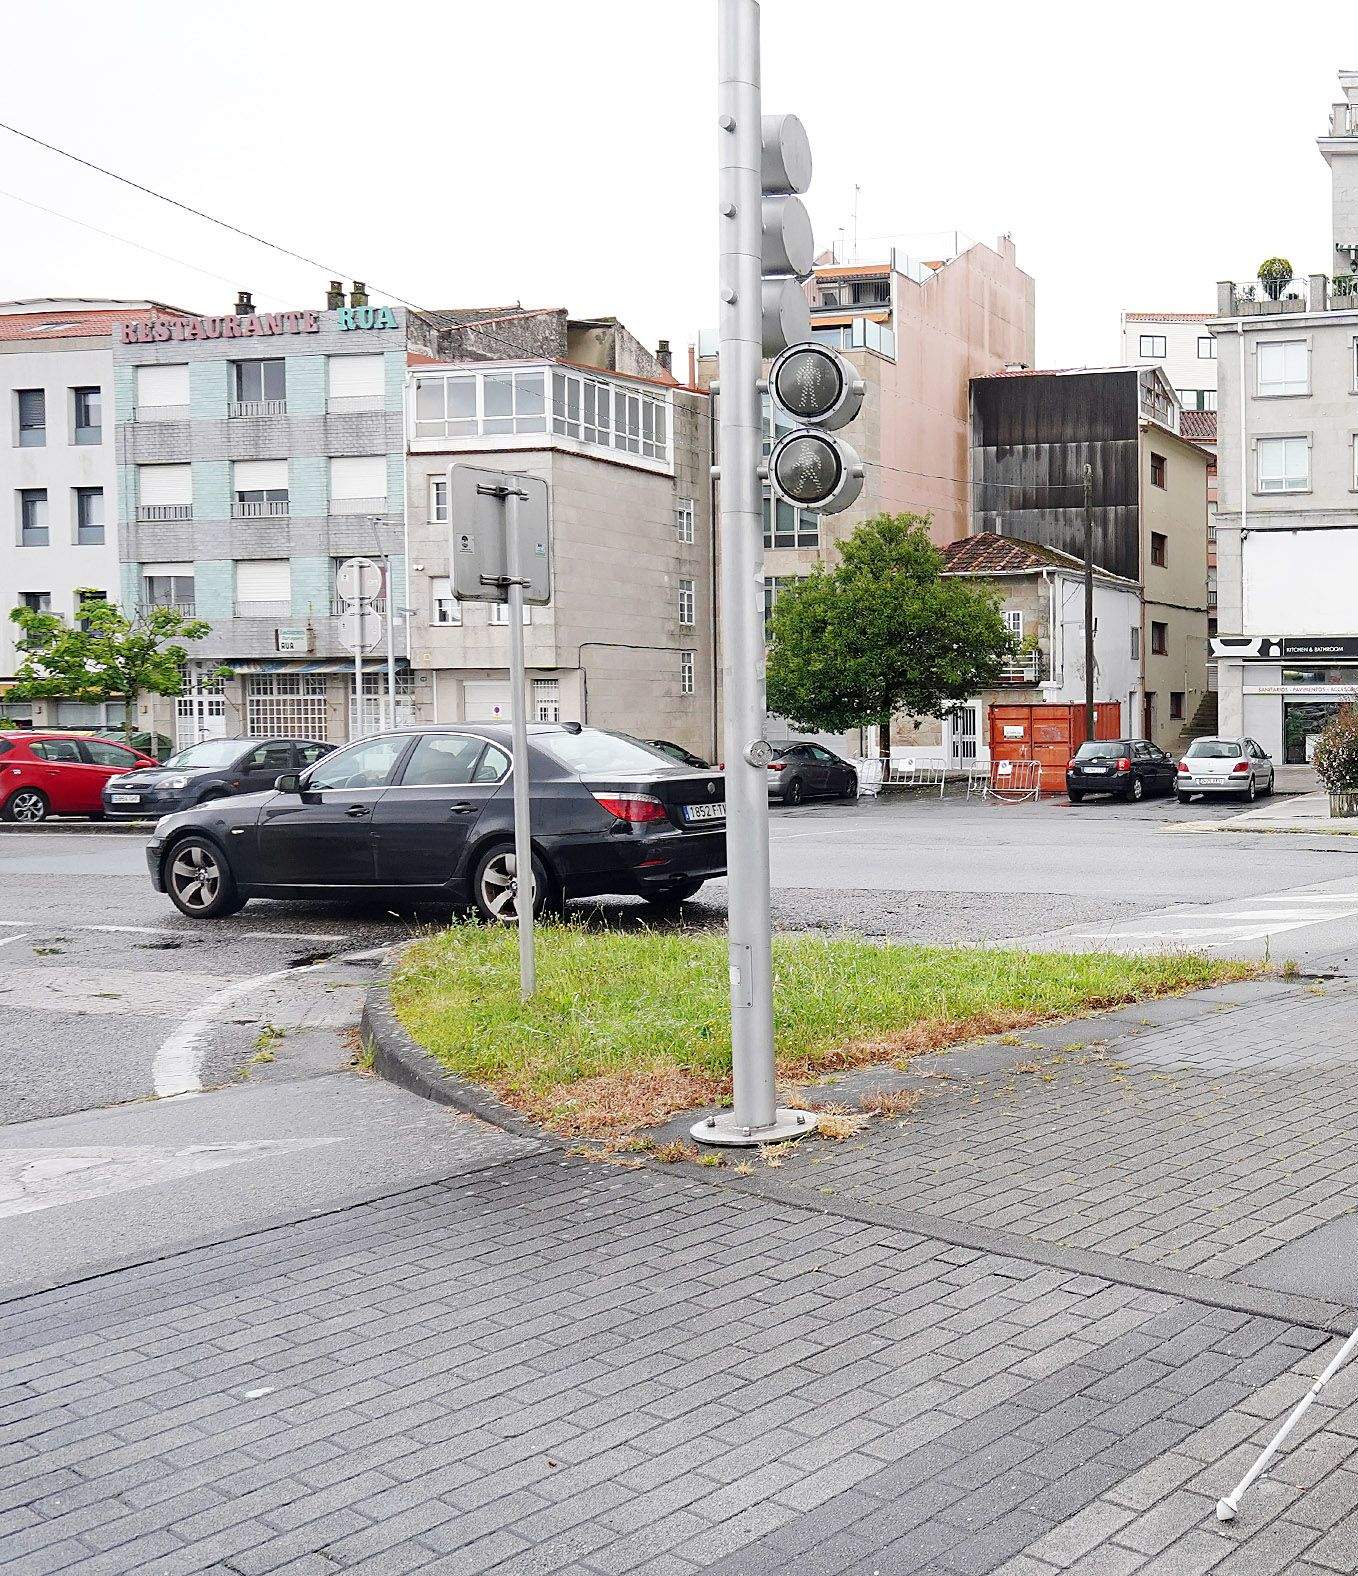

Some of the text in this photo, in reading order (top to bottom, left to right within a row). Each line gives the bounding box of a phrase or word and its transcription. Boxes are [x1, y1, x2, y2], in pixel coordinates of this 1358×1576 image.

[121, 306, 399, 343] RESTAURANTE RUA
[281, 642, 294, 650] RUA
[690, 805, 711, 817] 1852
